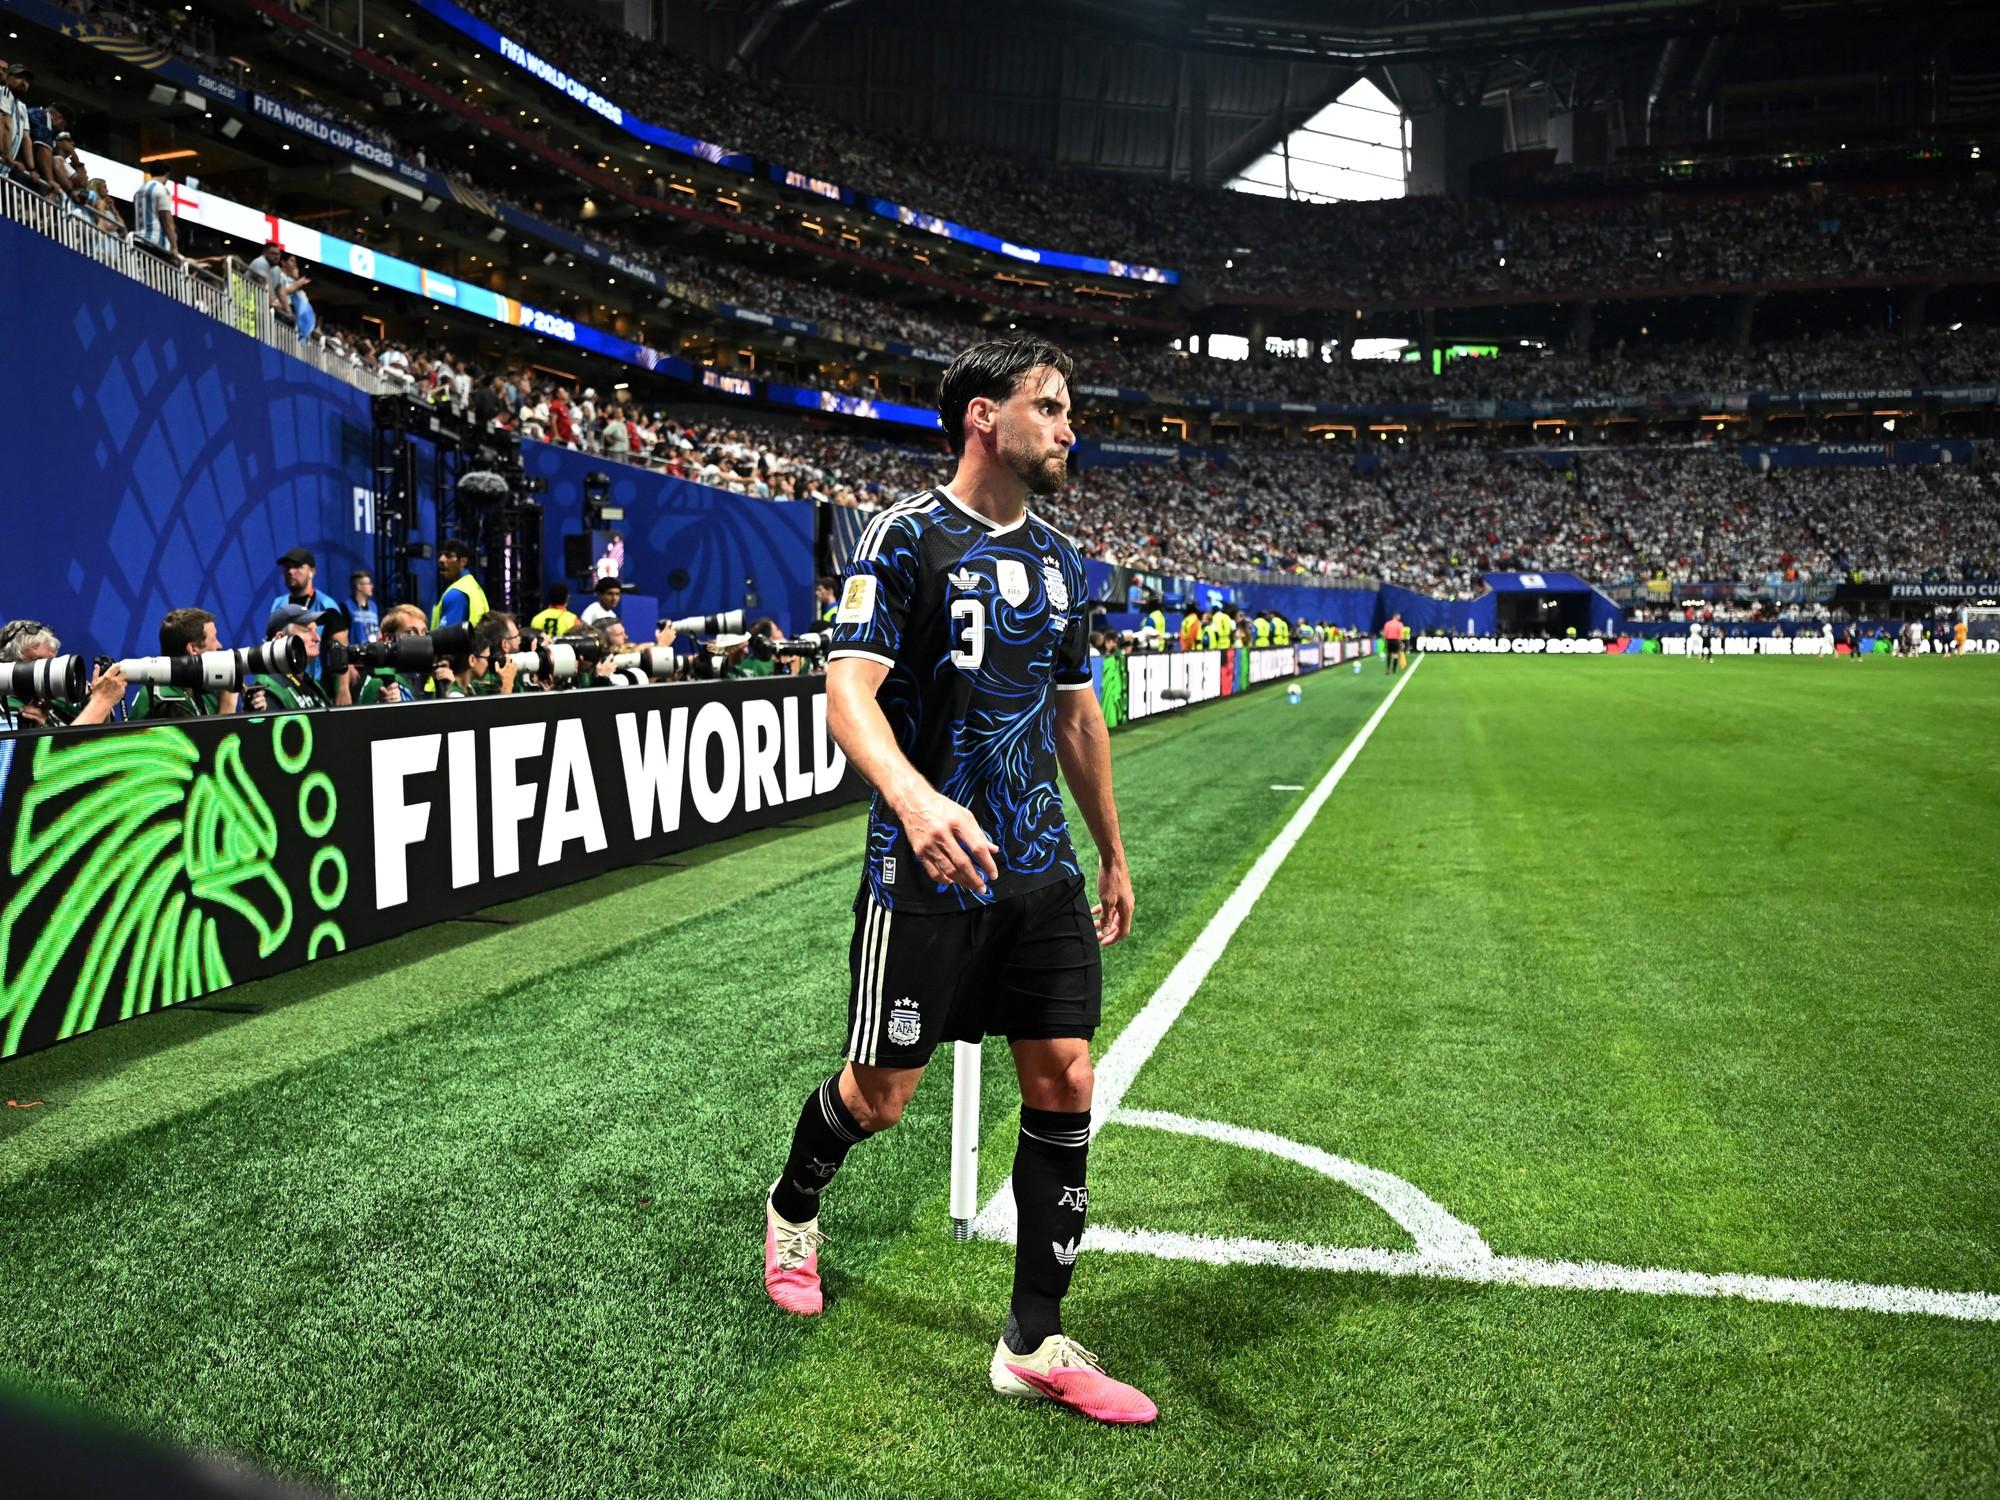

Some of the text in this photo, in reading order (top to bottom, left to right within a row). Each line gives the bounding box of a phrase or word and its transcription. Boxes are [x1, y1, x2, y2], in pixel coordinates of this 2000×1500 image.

[500, 36, 527, 68] FIFA
[526, 52, 566, 90] WORLD
[566, 78, 588, 102] CUP
[253, 94, 394, 168] FIFA WORLD CUP 2026
[785, 170, 841, 201] ATLANTA
[608, 254, 657, 285] ATLANTA
[533, 310, 576, 341] 2026
[1820, 391, 1856, 401] WORLD
[1857, 390, 1877, 400] CUP
[1877, 389, 1913, 399] 2026
[1891, 584, 2000, 597] FIFA WORLD CU
[950, 599, 986, 670] 3
[1416, 636, 1452, 653] FIFA
[1452, 636, 1511, 654] WORLD
[1511, 637, 1547, 654] CUP
[370, 693, 848, 910] FIFA WORLD
